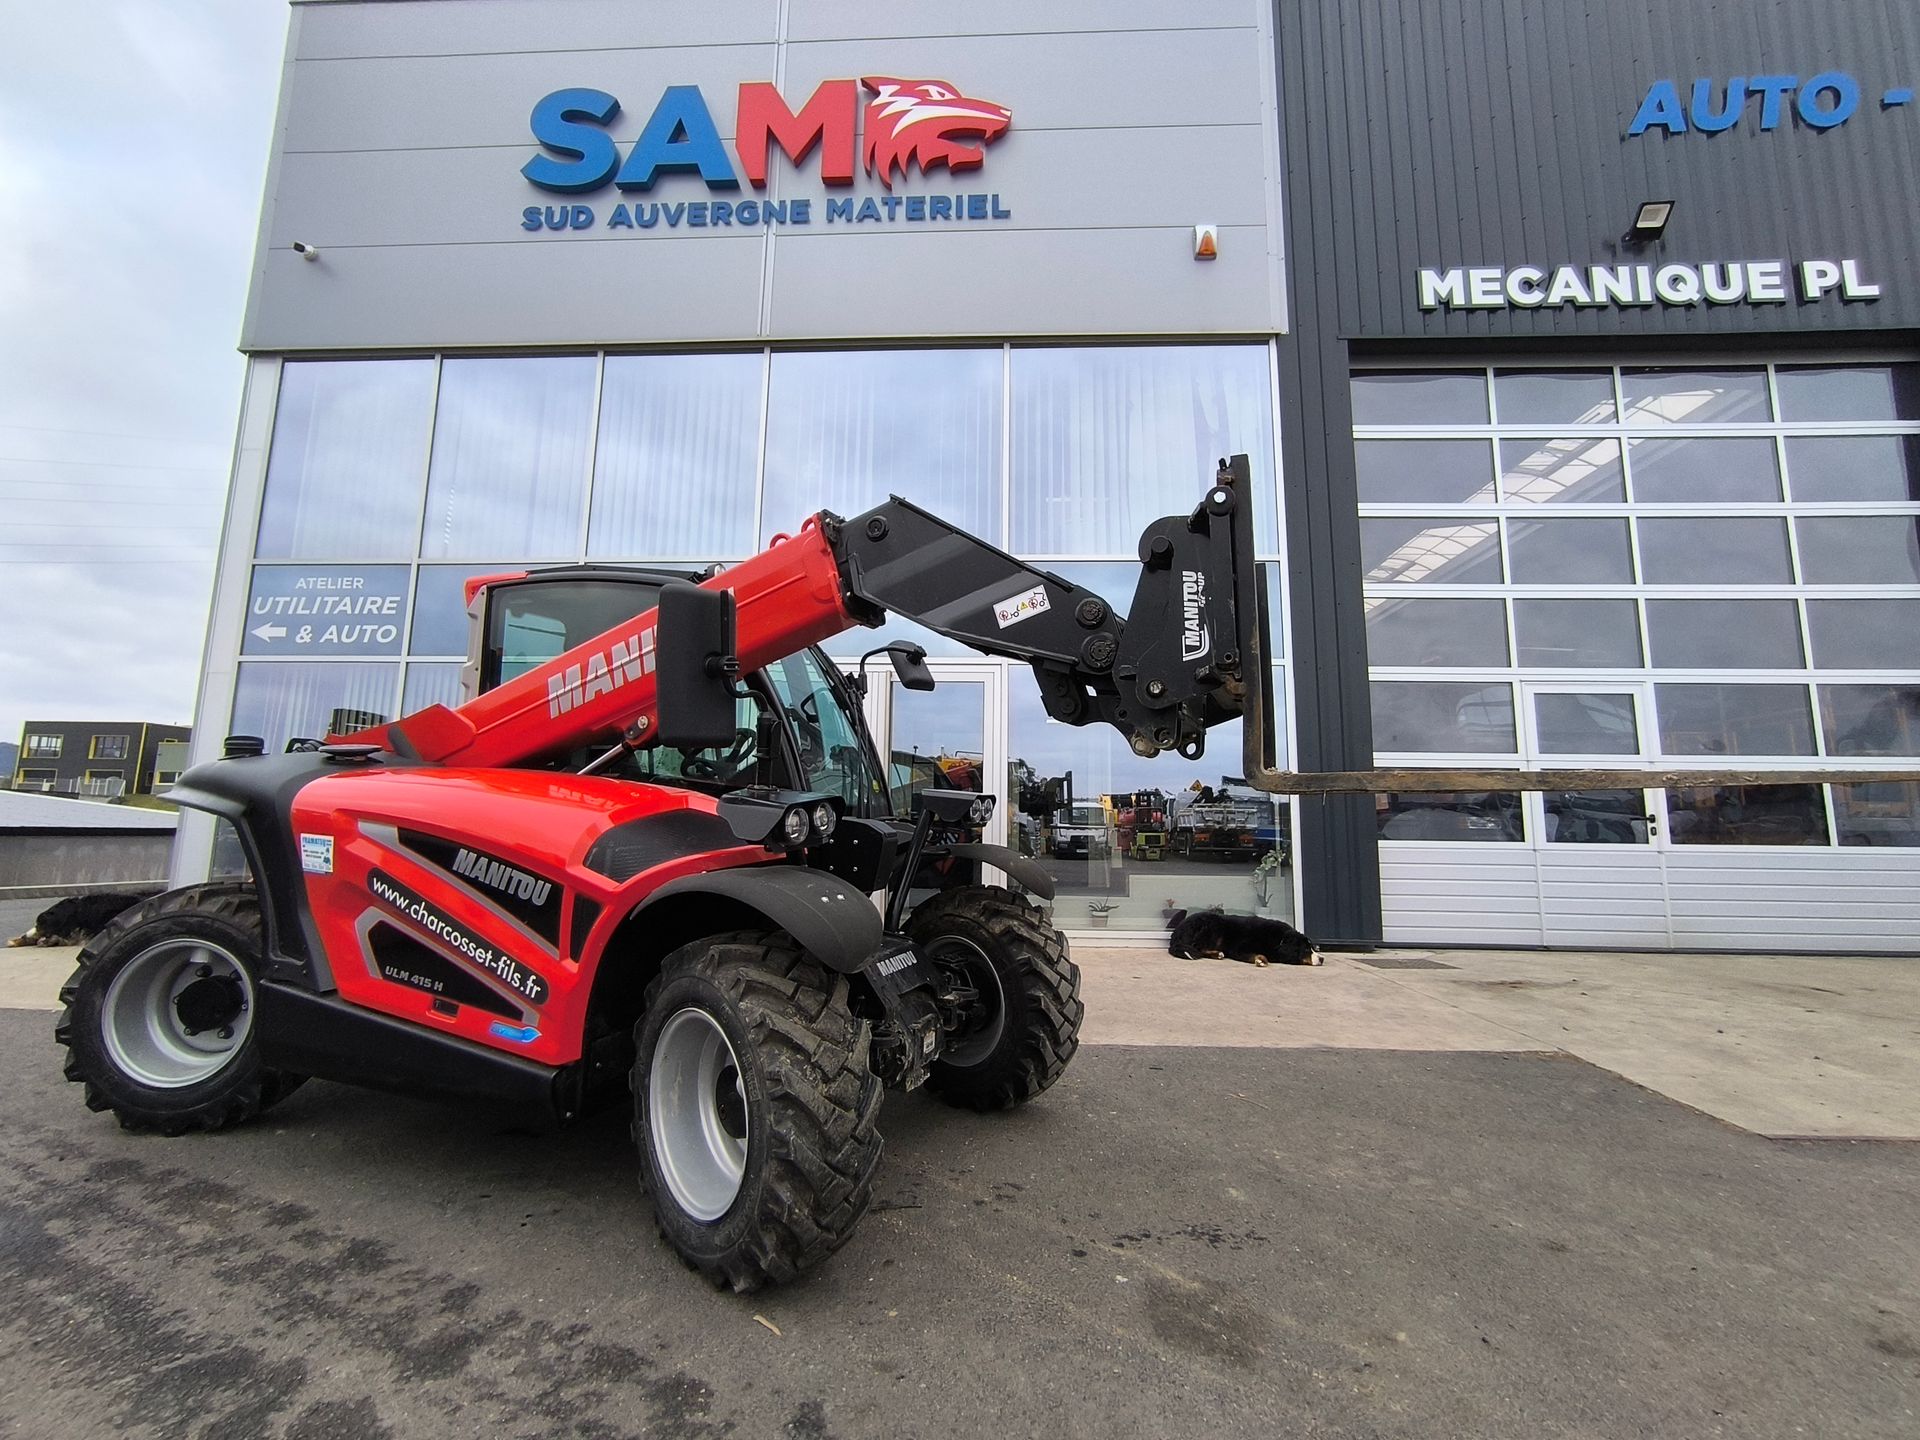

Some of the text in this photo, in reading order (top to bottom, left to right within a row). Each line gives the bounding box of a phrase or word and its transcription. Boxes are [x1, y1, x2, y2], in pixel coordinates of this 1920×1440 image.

[1627, 70, 1859, 135] AUTO
[520, 79, 860, 193] SAM
[521, 193, 1011, 231] SUD AUVERGNE MATERIEL
[1417, 258, 1881, 310] MECANIQUE PL
[253, 596, 401, 615] UTILITAIRE
[295, 577, 364, 590] ATELIER
[1182, 570, 1200, 646] MANITOU
[295, 624, 398, 643] & AUTO
[547, 624, 658, 720] MANI
[452, 848, 552, 906] MANITOU
[372, 876, 541, 1000] www.charcosset-fils.fr
[876, 950, 918, 977] MANITOU
[384, 965, 444, 992] ULM 415 H
